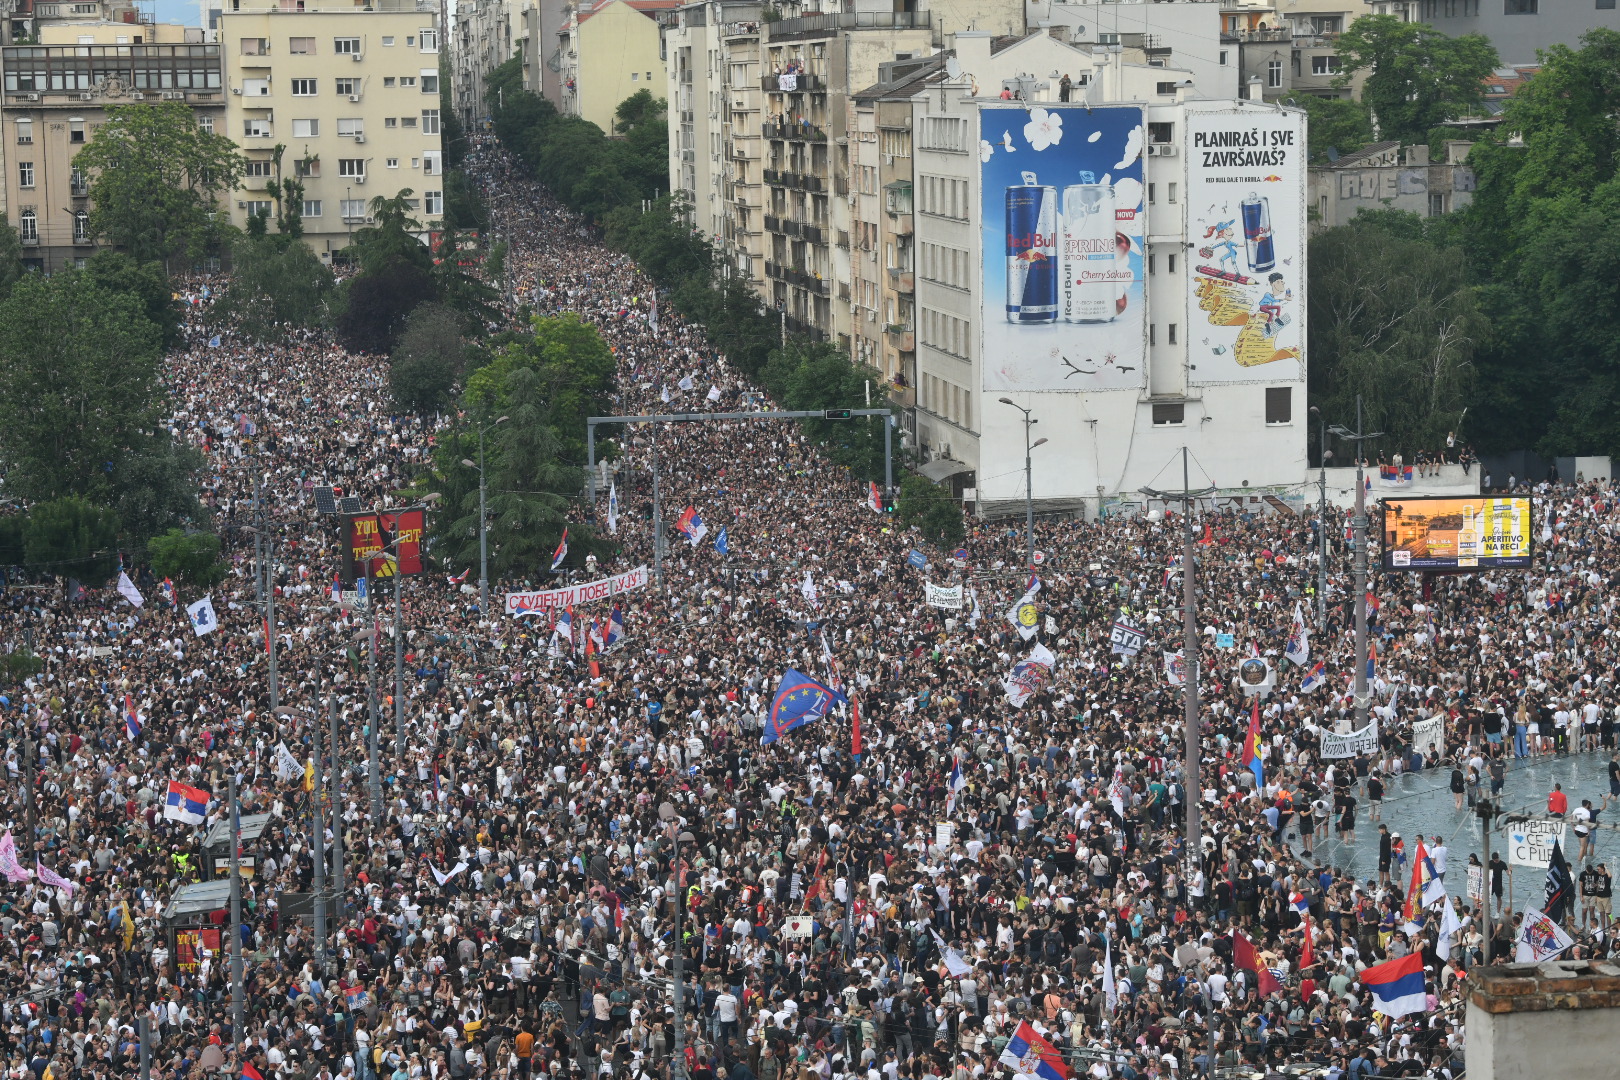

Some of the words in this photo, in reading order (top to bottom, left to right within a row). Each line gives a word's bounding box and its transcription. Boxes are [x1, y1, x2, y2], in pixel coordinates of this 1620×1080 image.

[1194, 128, 1258, 147] PLANIRAŠ
[1263, 131, 1267, 146] I
[1270, 130, 1294, 146] SVE
[1202, 147, 1286, 167] ZAVRŠAVAŠ?
[1007, 233, 1031, 247] Red
[1034, 233, 1056, 247] Bull
[1064, 239, 1115, 253] SPRING
[1064, 264, 1072, 289] Bull
[1081, 270, 1106, 280] Cherry
[1106, 270, 1132, 279] Sakura
[1064, 291, 1072, 316] Red
[354, 519, 379, 536] YOU
[398, 528, 422, 544] GOT
[1480, 534, 1524, 543] APERITIVO
[509, 590, 574, 610] СТУДЕНТИ
[1111, 628, 1142, 649] БГД
[1526, 834, 1545, 847] СЕ
